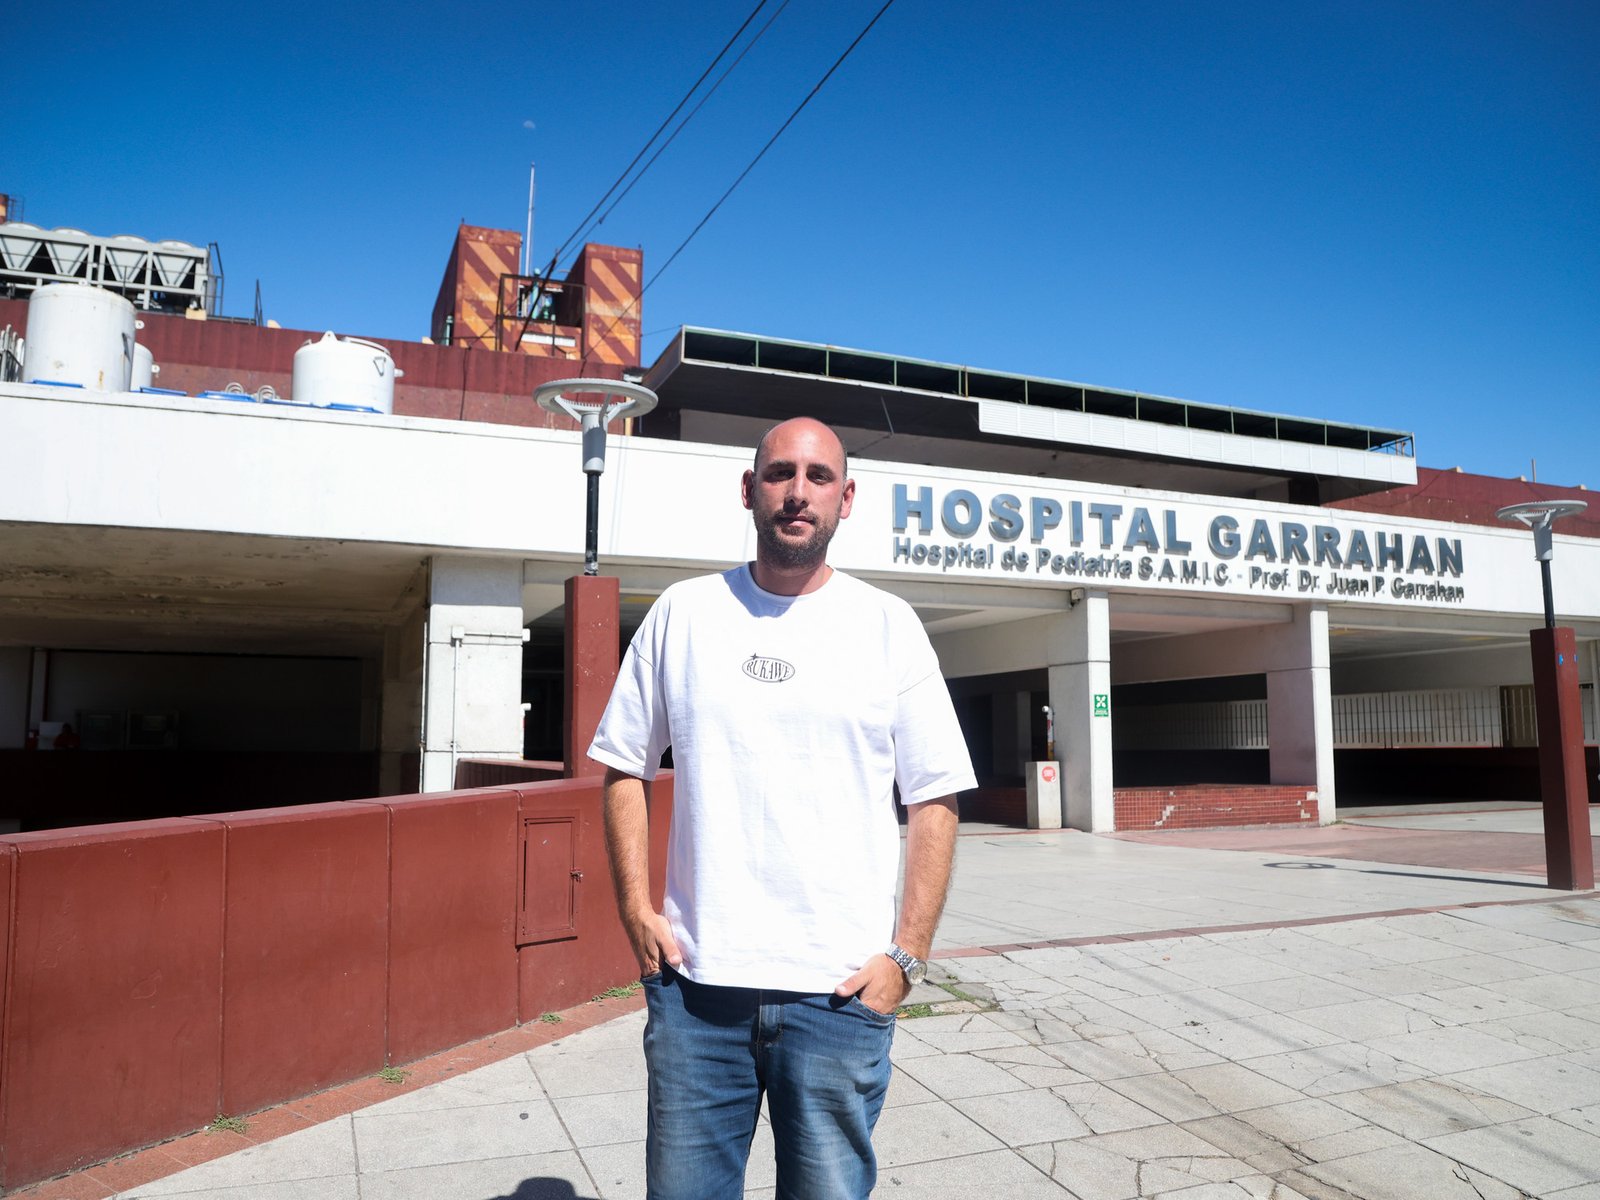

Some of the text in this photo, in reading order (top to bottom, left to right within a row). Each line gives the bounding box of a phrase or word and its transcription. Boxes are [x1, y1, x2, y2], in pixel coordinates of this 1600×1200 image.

[892, 483, 1464, 578] HOSPITAL GARRAHAN
[893, 536, 994, 572] Hospital
[1001, 545, 1029, 573] de
[1249, 565, 1291, 591] Prof.
[1297, 569, 1320, 593] Dr.
[1326, 572, 1369, 598] Juan
[1372, 575, 1386, 598] P.
[1391, 577, 1465, 604] Garrahan
